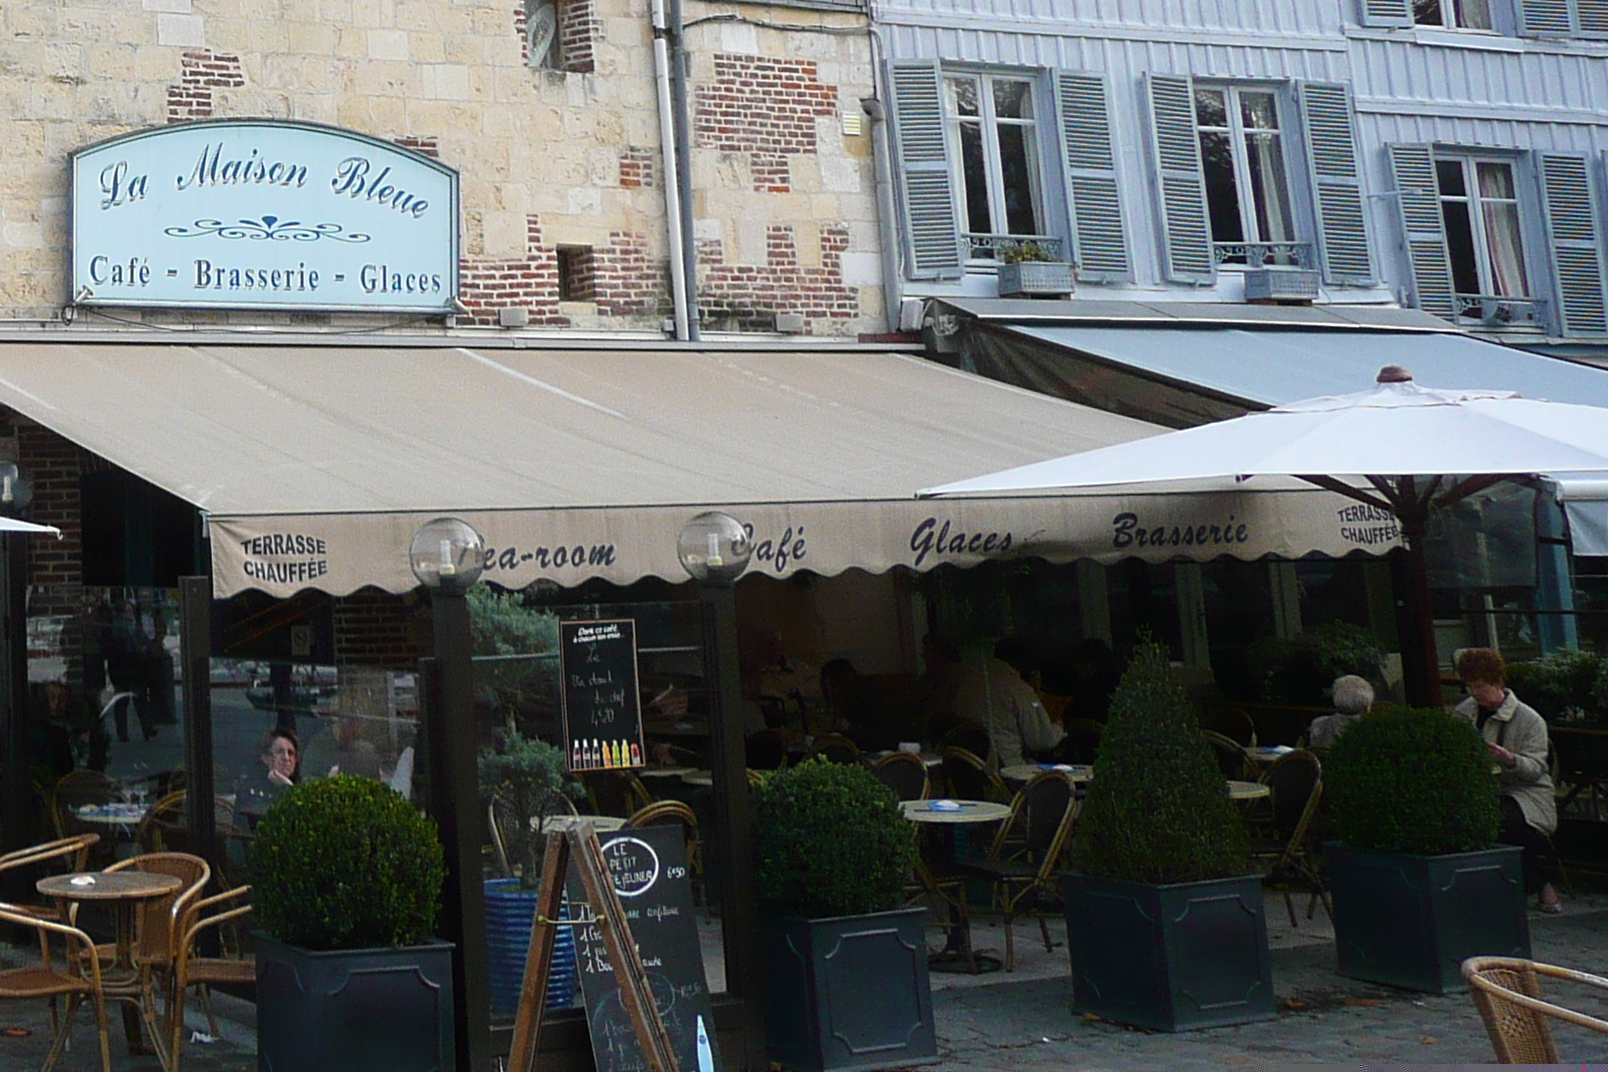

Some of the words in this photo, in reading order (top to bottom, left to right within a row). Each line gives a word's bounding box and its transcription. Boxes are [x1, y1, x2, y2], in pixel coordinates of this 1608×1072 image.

[100, 159, 149, 210] La
[176, 141, 309, 191] Maison
[331, 156, 430, 219] Bleue
[89, 255, 150, 287] Café
[194, 259, 320, 291] Brasserie
[360, 264, 442, 294] Glaces
[240, 533, 326, 555] TERRASSE
[731, 523, 806, 572] Café
[910, 517, 1012, 567] Glaces
[1112, 512, 1248, 548] Brasserie
[243, 557, 328, 583] CHAUFFÉE
[609, 856, 637, 871] PETIT
[613, 843, 628, 856] LE
